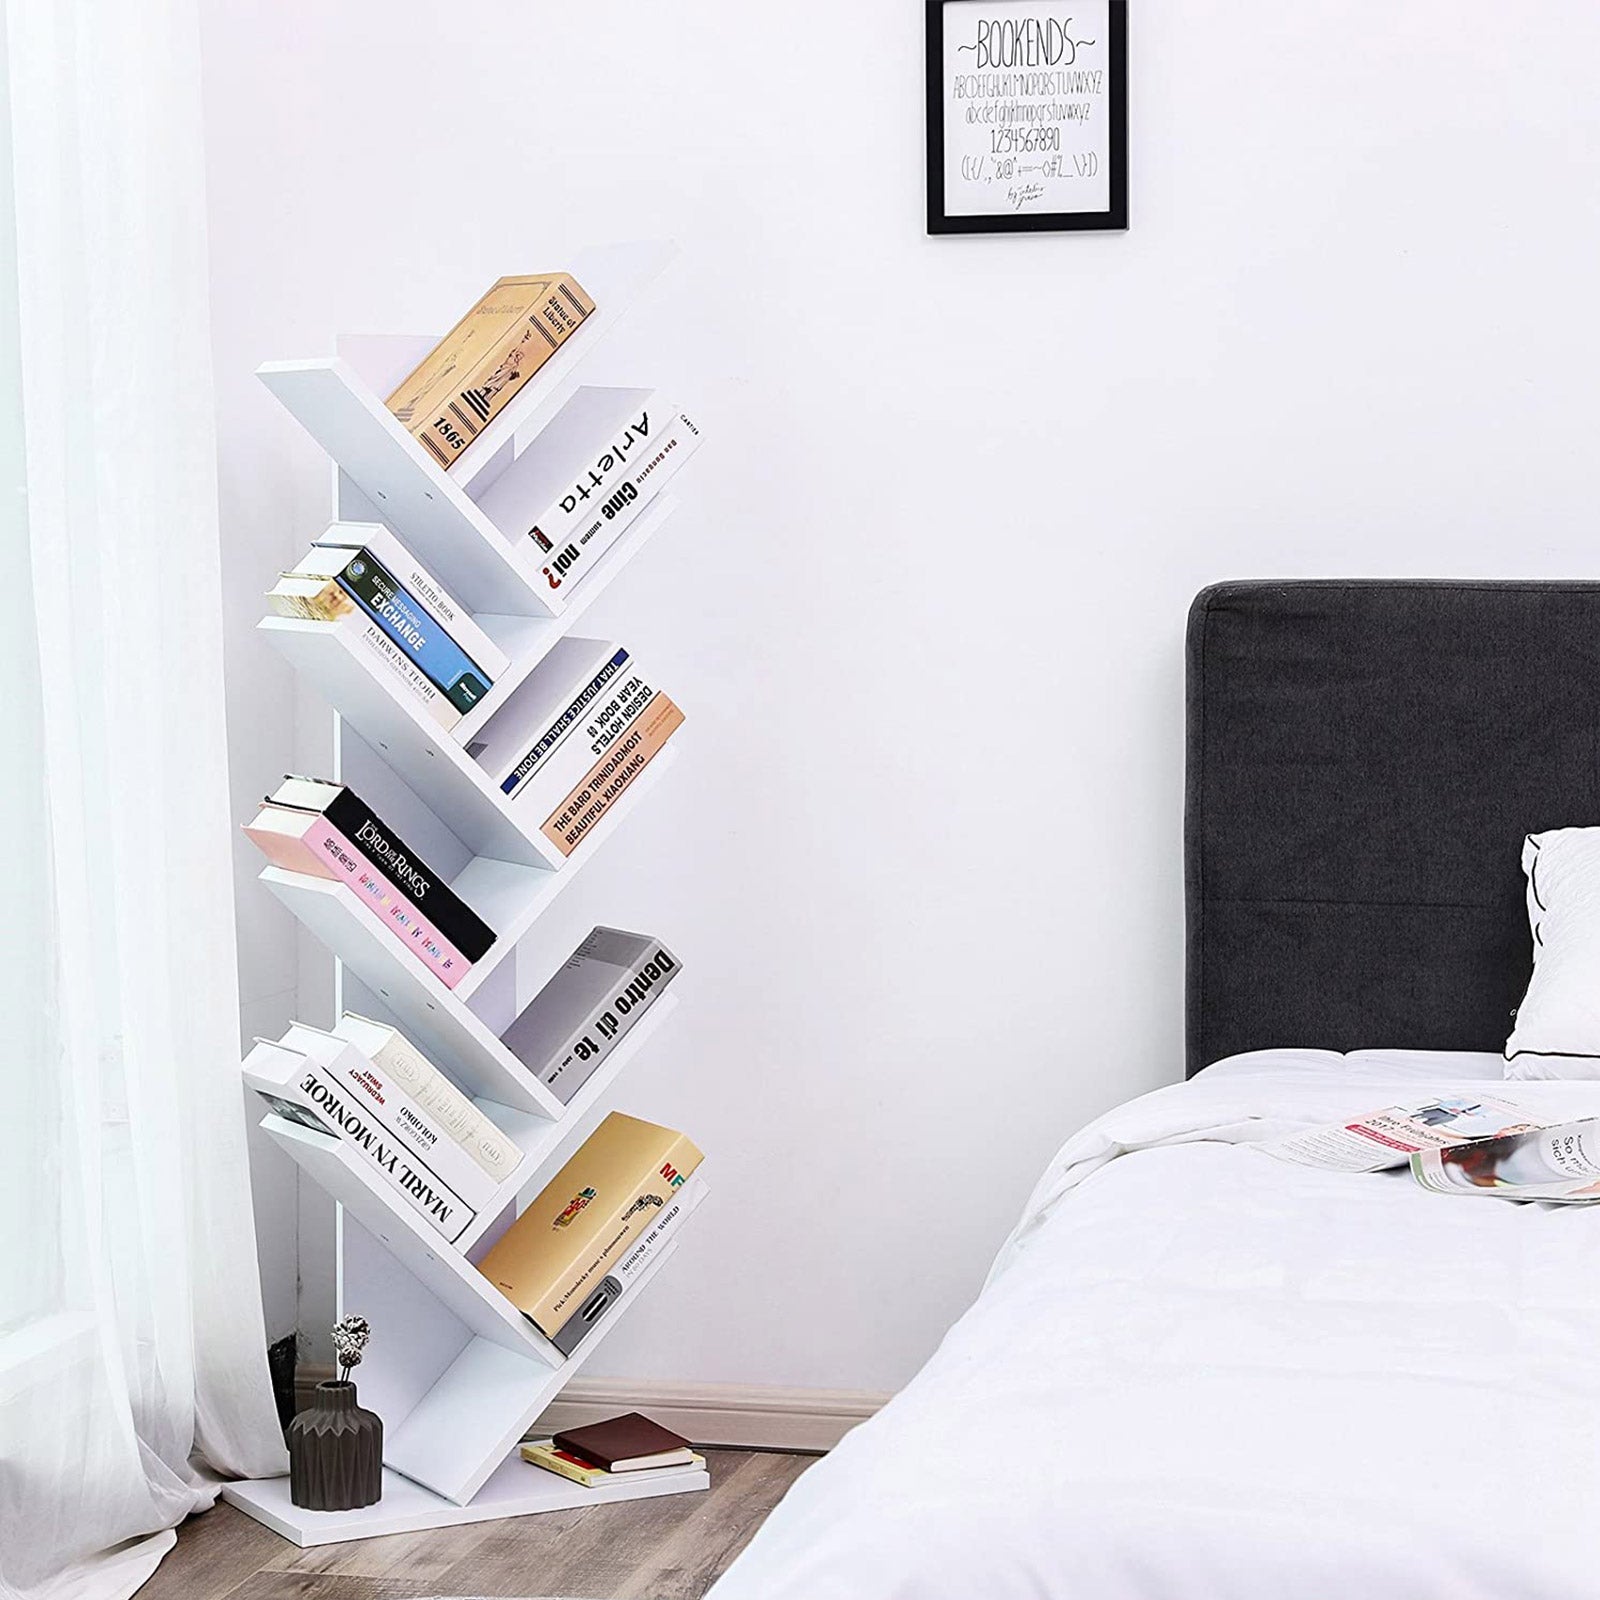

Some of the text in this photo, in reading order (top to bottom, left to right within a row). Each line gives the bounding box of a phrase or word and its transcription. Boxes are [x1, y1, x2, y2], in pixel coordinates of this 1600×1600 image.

[977, 17, 1076, 69] BOOKENDS
[990, 127, 1061, 154] 1234567890
[542, 307, 566, 335] Liberty
[433, 417, 466, 450] 1865
[559, 411, 649, 514] Arletta
[601, 481, 639, 520] Cine
[371, 575, 395, 600] SECURE
[370, 592, 426, 651] EXCHANGE
[366, 626, 436, 699] DARWINS TEORI
[616, 676, 643, 703] YEAR
[513, 660, 619, 780] THAT JUSTICE SHALL BE DONE
[590, 685, 653, 755] DESIGN HOTELS
[595, 701, 620, 731] BOOK
[553, 730, 643, 833] THE BARD TRINIDADMOST
[565, 753, 646, 845] BEAUTIFUL XIAOXIANG
[354, 819, 390, 855] LORD
[391, 853, 431, 899] RINGS
[574, 949, 676, 1061] Dentro di te
[300, 1073, 378, 1150] MONROE
[1551, 1138, 1566, 1165] sich
[1563, 1136, 1574, 1154] So
[621, 1244, 647, 1273] AROUND
[645, 1231, 659, 1245] THE
[657, 1206, 680, 1232] WORLD
